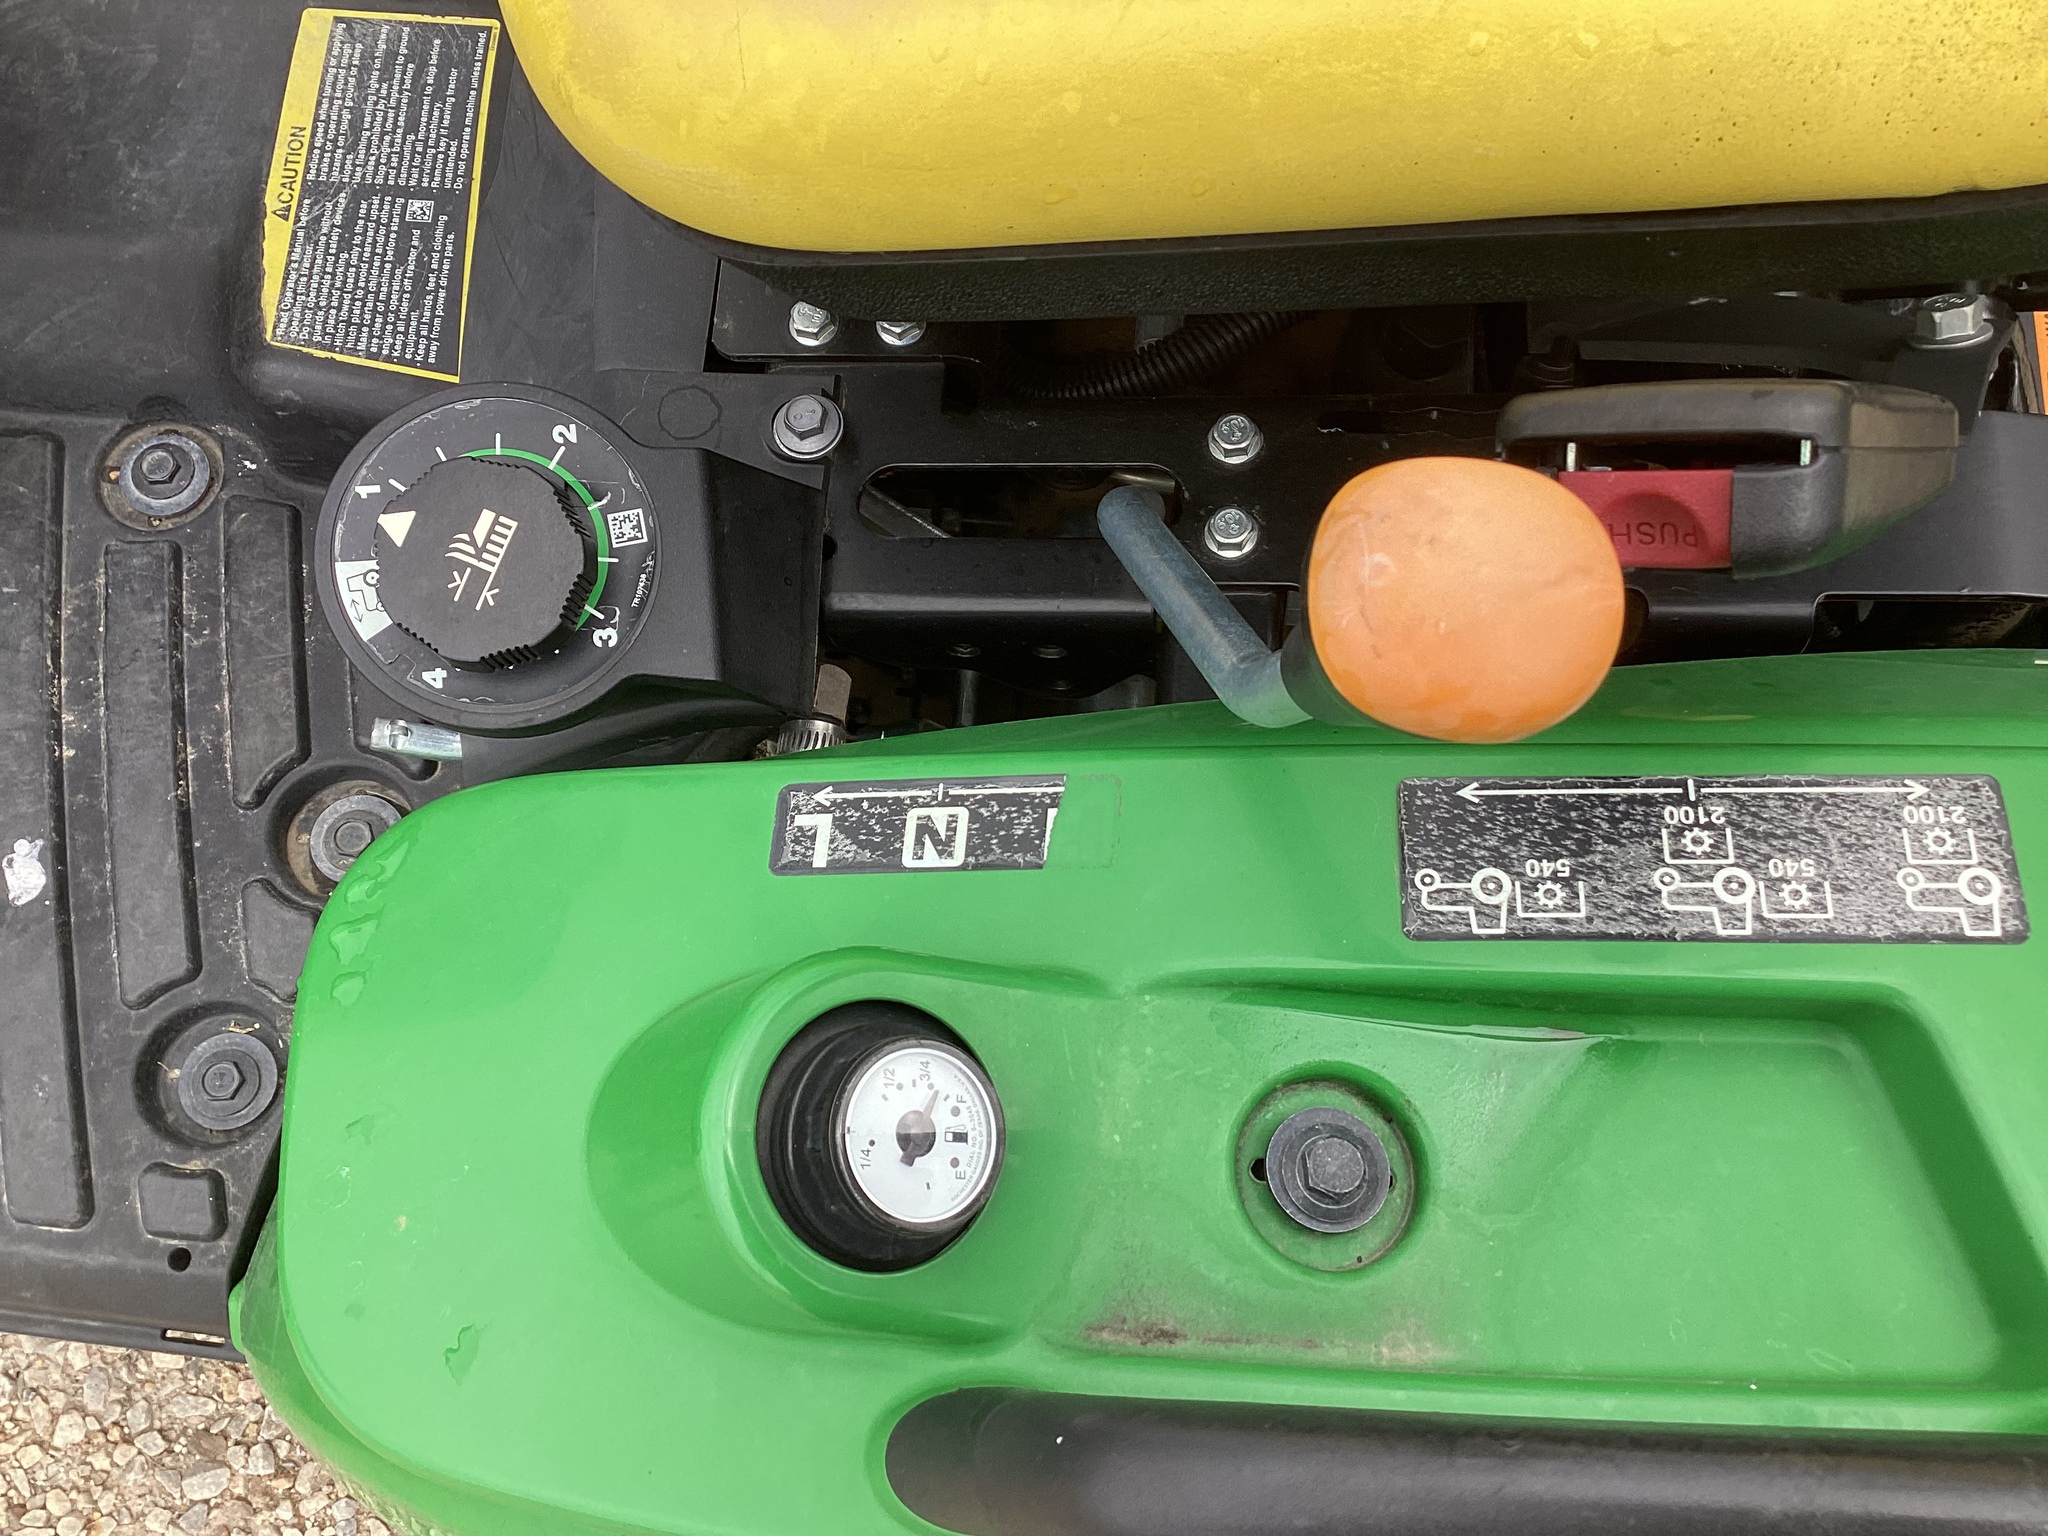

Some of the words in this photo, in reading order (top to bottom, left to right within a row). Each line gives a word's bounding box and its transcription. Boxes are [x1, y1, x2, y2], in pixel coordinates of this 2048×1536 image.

[331, 22, 346, 56] applying
[374, 24, 390, 57] highway
[398, 26, 410, 54] ground
[428, 38, 441, 64] before
[473, 30, 486, 60] trained.
[329, 56, 338, 66] or
[340, 42, 352, 67] rough
[351, 42, 364, 65] steep
[373, 57, 382, 69] on
[395, 54, 405, 64] to
[321, 66, 337, 97] turning
[334, 67, 346, 98] around
[349, 66, 358, 76] or
[367, 69, 380, 94] lights
[401, 62, 415, 89] before
[425, 65, 438, 84] stop
[445, 67, 458, 96] tractor
[470, 60, 481, 89] unless
[344, 76, 356, 107] ground
[377, 80, 389, 97] law.
[387, 64, 403, 107] implement
[423, 84, 433, 95] to
[318, 97, 330, 121] when
[362, 94, 377, 129] warning
[375, 98, 388, 110] by
[440, 96, 455, 127] leaving
[464, 89, 477, 125] machine
[326, 98, 342, 139] operating
[338, 107, 351, 134] rough
[383, 107, 396, 131] lower
[417, 95, 431, 140] movement
[427, 100, 443, 146] machinery.
[313, 121, 325, 147] speed
[336, 134, 345, 147] on
[369, 110, 384, 154] prohibited
[390, 127, 404, 152] brake
[438, 127, 448, 135] if
[459, 126, 471, 159] operate
[323, 140, 332, 151] or
[354, 129, 371, 165] flashing
[379, 132, 392, 163] engine,
[414, 140, 424, 152] all
[436, 136, 449, 152] key
[277, 126, 307, 204] CAUTION
[305, 147, 320, 180] Reduce
[316, 151, 330, 181] brakes
[327, 147, 343, 182] hazards
[340, 151, 354, 182] slopes.
[363, 154, 376, 184] unless
[389, 152, 399, 167] set
[396, 132, 415, 186] dismounting.
[411, 152, 422, 166] for
[420, 147, 436, 187] servicing
[430, 152, 444, 188] Remove
[443, 138, 458, 188] unattended.
[456, 159, 466, 175] not
[350, 165, 362, 183] Use
[373, 163, 387, 184] Stop
[386, 167, 396, 185] and
[407, 166, 419, 186] Wait
[453, 176, 463, 189] Do
[296, 197, 310, 227] before
[319, 200, 333, 234] without
[358, 199, 368, 218] rear
[379, 195, 391, 224] others
[389, 196, 404, 231] starting
[353, 218, 365, 234] the
[411, 228, 421, 246] and
[432, 214, 448, 251] clothing
[290, 227, 305, 261] Manual
[328, 226, 342, 254] safety
[351, 234, 362, 245] to
[361, 221, 375, 261] rearward
[374, 224, 386, 254] and/or
[383, 231, 397, 261] before
[444, 231, 455, 257] parts.
[298, 243, 313, 275] tractor.
[312, 234, 327, 274] machine
[324, 254, 335, 273] and
[349, 245, 362, 265] only
[404, 247, 418, 278] tractor
[430, 251, 440, 269] and
[333, 250, 349, 288] working.
[343, 266, 356, 292] loads
[357, 261, 368, 288] avoid
[367, 254, 381, 292] children
[378, 261, 392, 301] machine
[425, 270, 438, 291] feet,
[437, 257, 451, 286] driven
[280, 261, 298, 310] Operator's
[295, 275, 307, 294] this
[306, 274, 319, 308] operate
[317, 273, 331, 307] shields
[353, 288, 364, 299] to
[402, 278, 412, 291] off
[330, 288, 340, 307] and
[337, 292, 351, 321] towed
[362, 292, 375, 325] certain
[375, 301, 385, 312] of
[397, 292, 410, 320] riders
[420, 292, 435, 323] hands,
[434, 287, 446, 316] power
[275, 310, 289, 335] Read
[288, 294, 305, 337] operating
[303, 308, 313, 325] not
[324, 307, 337, 333] place
[350, 299, 362, 324] plate
[386, 311, 395, 323] or
[298, 325, 310, 339] Do
[312, 307, 326, 342] guards,
[333, 321, 346, 346] Hitch
[344, 324, 358, 348] hitch
[371, 313, 383, 336] clear
[395, 319, 406, 332] all
[404, 309, 419, 359] equipment.
[418, 323, 429, 336] all
[429, 316, 441, 339] from
[321, 334, 332, 344] in
[356, 325, 369, 350] Make
[369, 336, 379, 352] are
[381, 323, 393, 355] engine
[391, 332, 405, 356] Keep
[414, 336, 428, 361] Keep
[427, 339, 440, 363] away
[552, 423, 578, 445] 2
[354, 484, 381, 499] 1
[1606, 521, 1698, 548] PUSH
[593, 627, 619, 648] 3
[421, 667, 447, 689] 4
[1664, 804, 1726, 824] 2100
[1903, 804, 1967, 824] 2100
[912, 812, 959, 861] N
[1524, 858, 1570, 878] 540
[1768, 858, 1815, 878] 540
[883, 1067, 896, 1089] 1/2
[919, 1060, 931, 1082] 3/4
[956, 1093, 967, 1104] F
[860, 1148, 872, 1169] 1/4
[966, 1150, 976, 1169] DIAL
[955, 1169, 966, 1180] E
